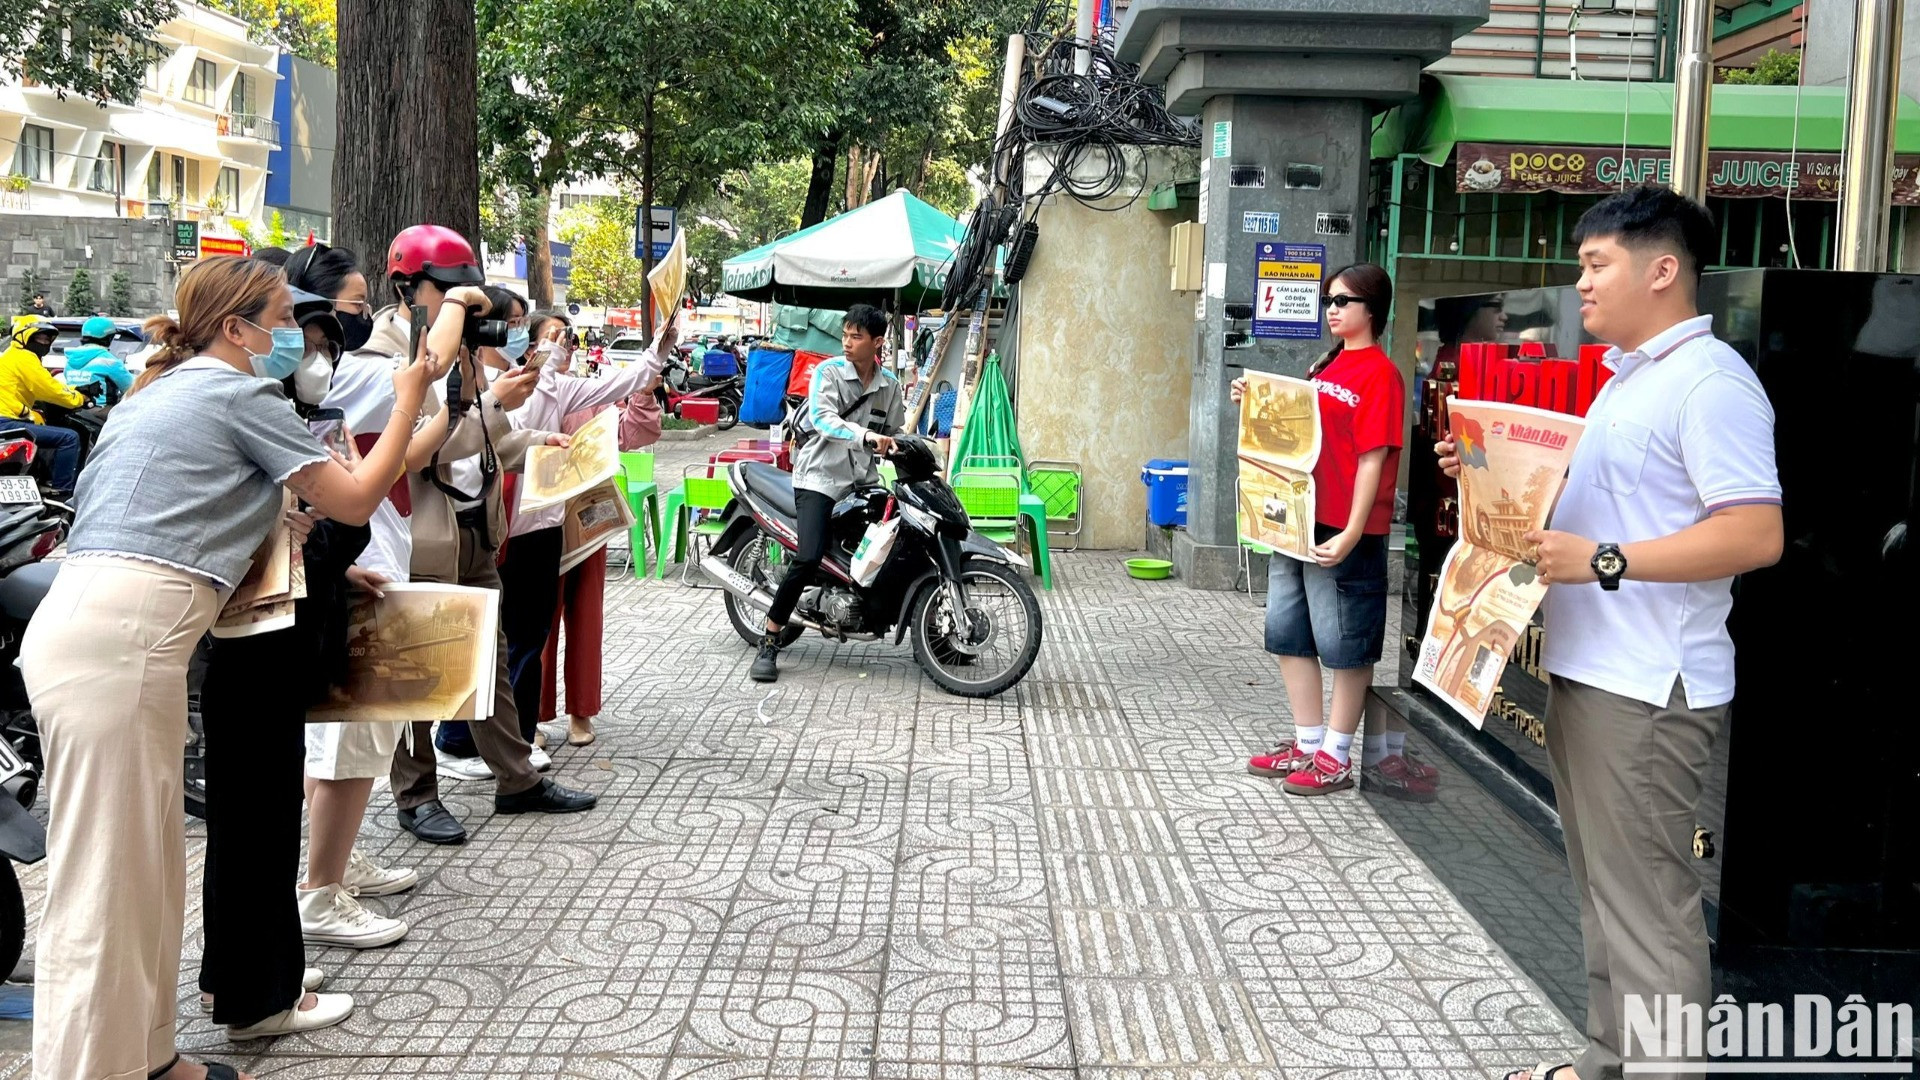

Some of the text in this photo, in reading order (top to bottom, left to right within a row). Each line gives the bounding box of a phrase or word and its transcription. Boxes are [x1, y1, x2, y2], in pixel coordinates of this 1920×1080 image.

[1520, 173, 1583, 183] CAFE & JUICE
[1595, 156, 1672, 185] CAFE
[1712, 160, 1800, 188] JUICE
[1258, 217, 1268, 233] 115
[1268, 218, 1278, 233] 116
[1508, 423, 1568, 447] Nhân Dân
[349, 647, 366, 657] 390
